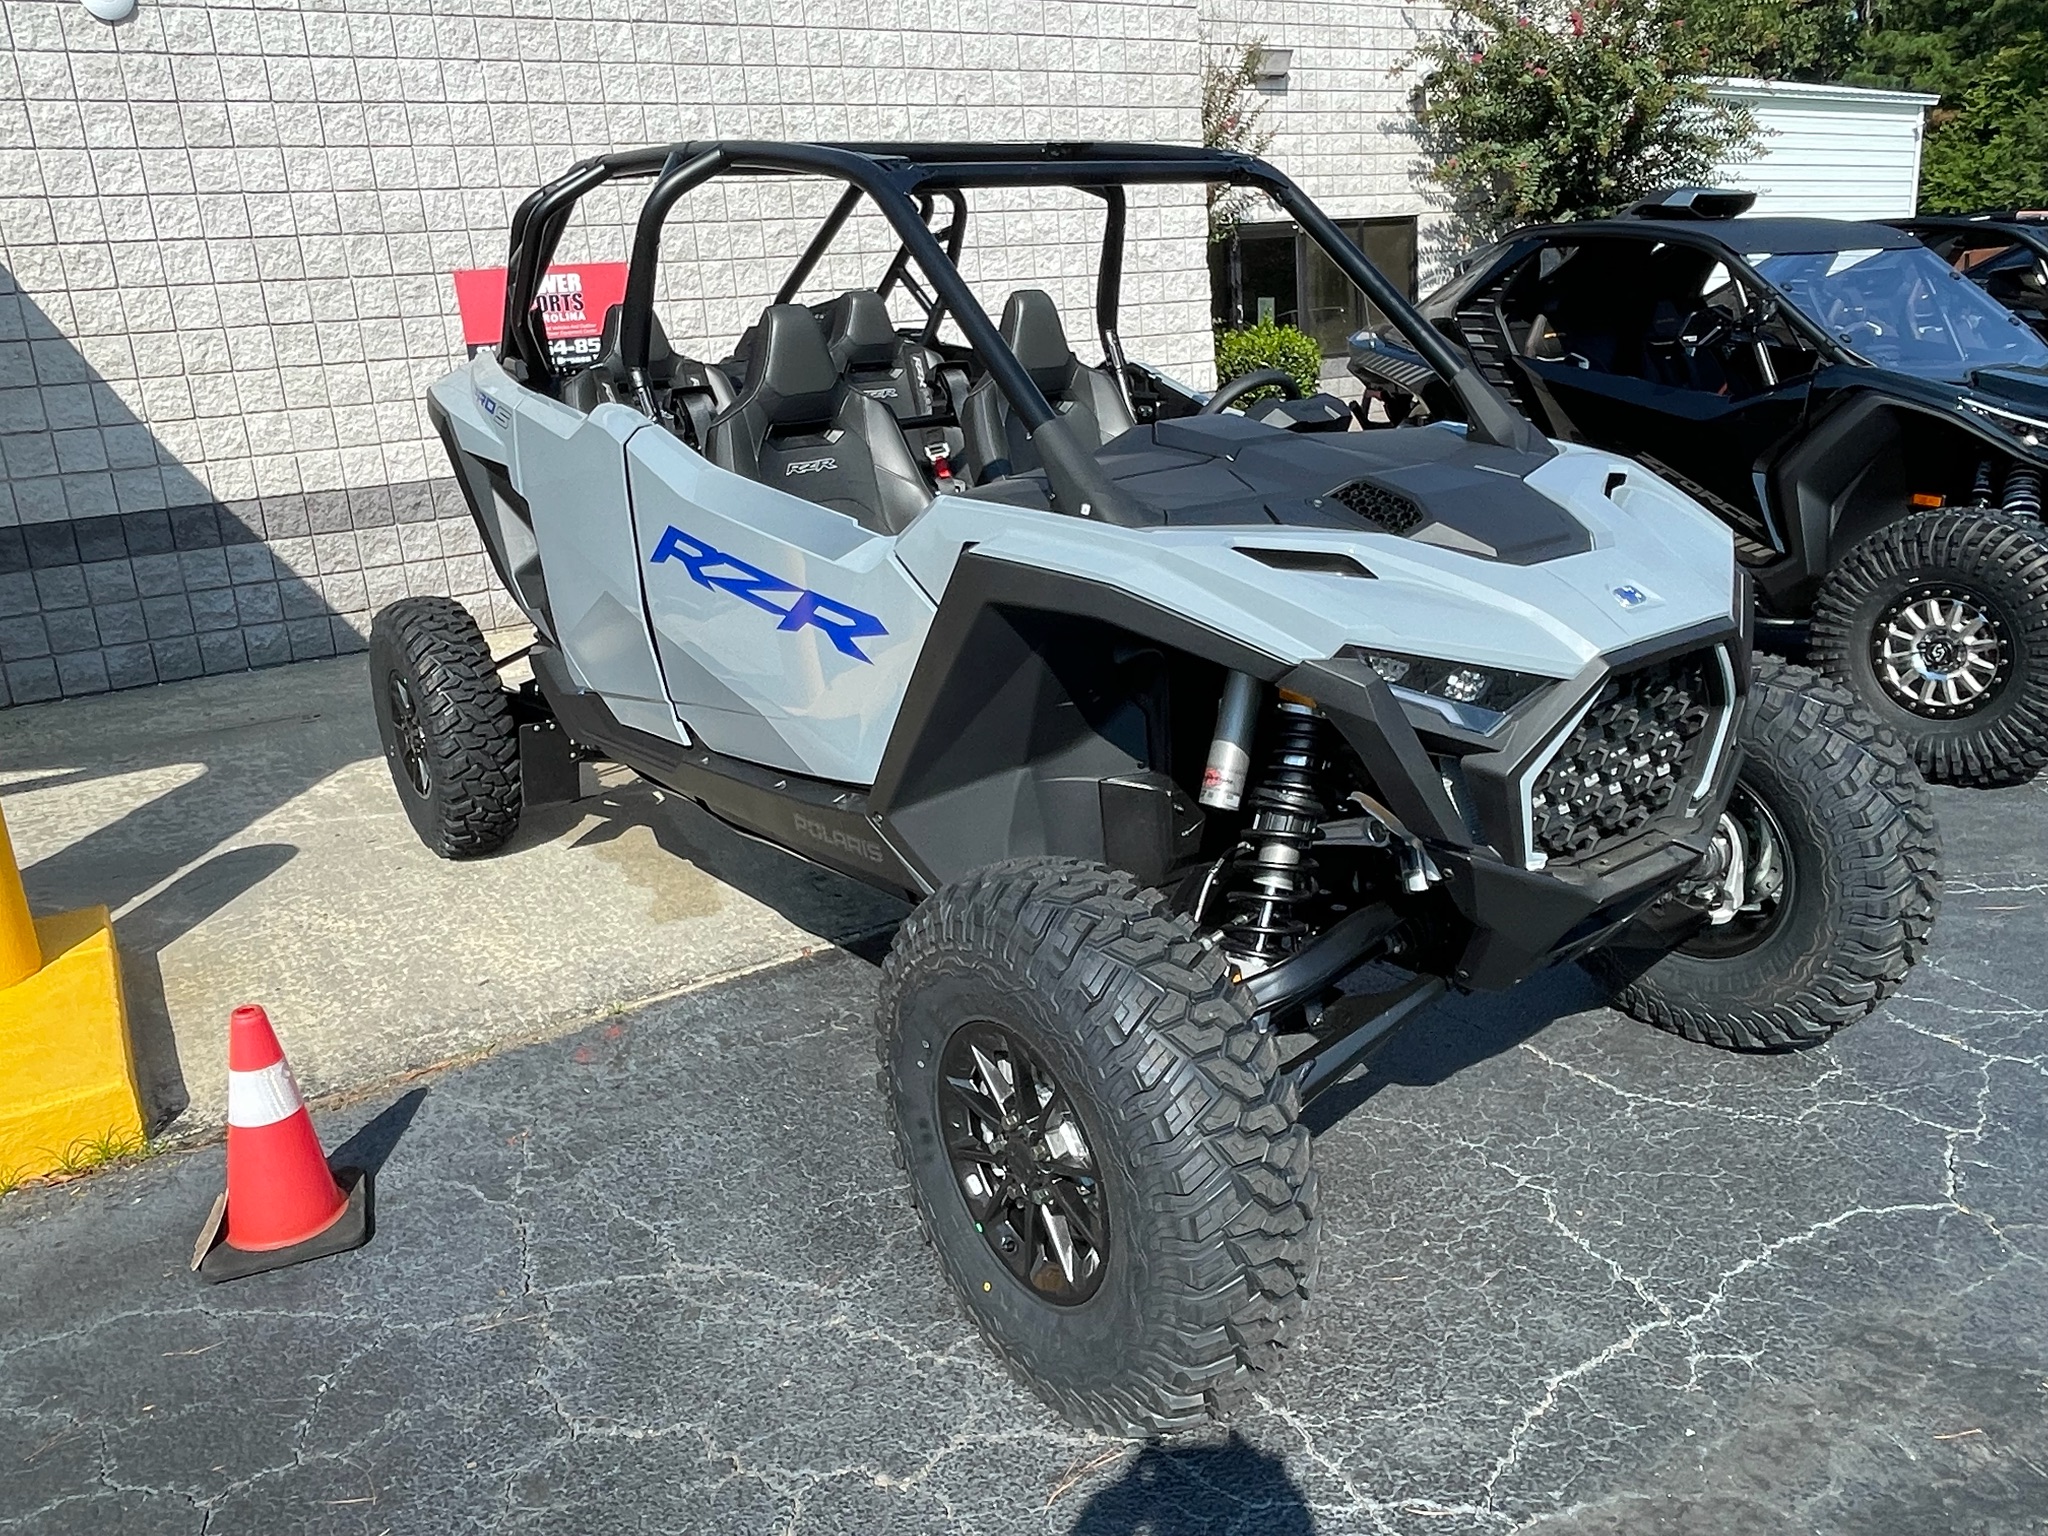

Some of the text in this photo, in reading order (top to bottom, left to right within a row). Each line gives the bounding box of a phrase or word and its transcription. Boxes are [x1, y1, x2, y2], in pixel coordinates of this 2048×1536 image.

[538, 273, 582, 293] WER
[537, 293, 584, 312] ORTS
[543, 311, 586, 323] ROLINA
[786, 457, 838, 476] RZR
[650, 525, 890, 666] RZR
[793, 812, 884, 863] POLARIS
